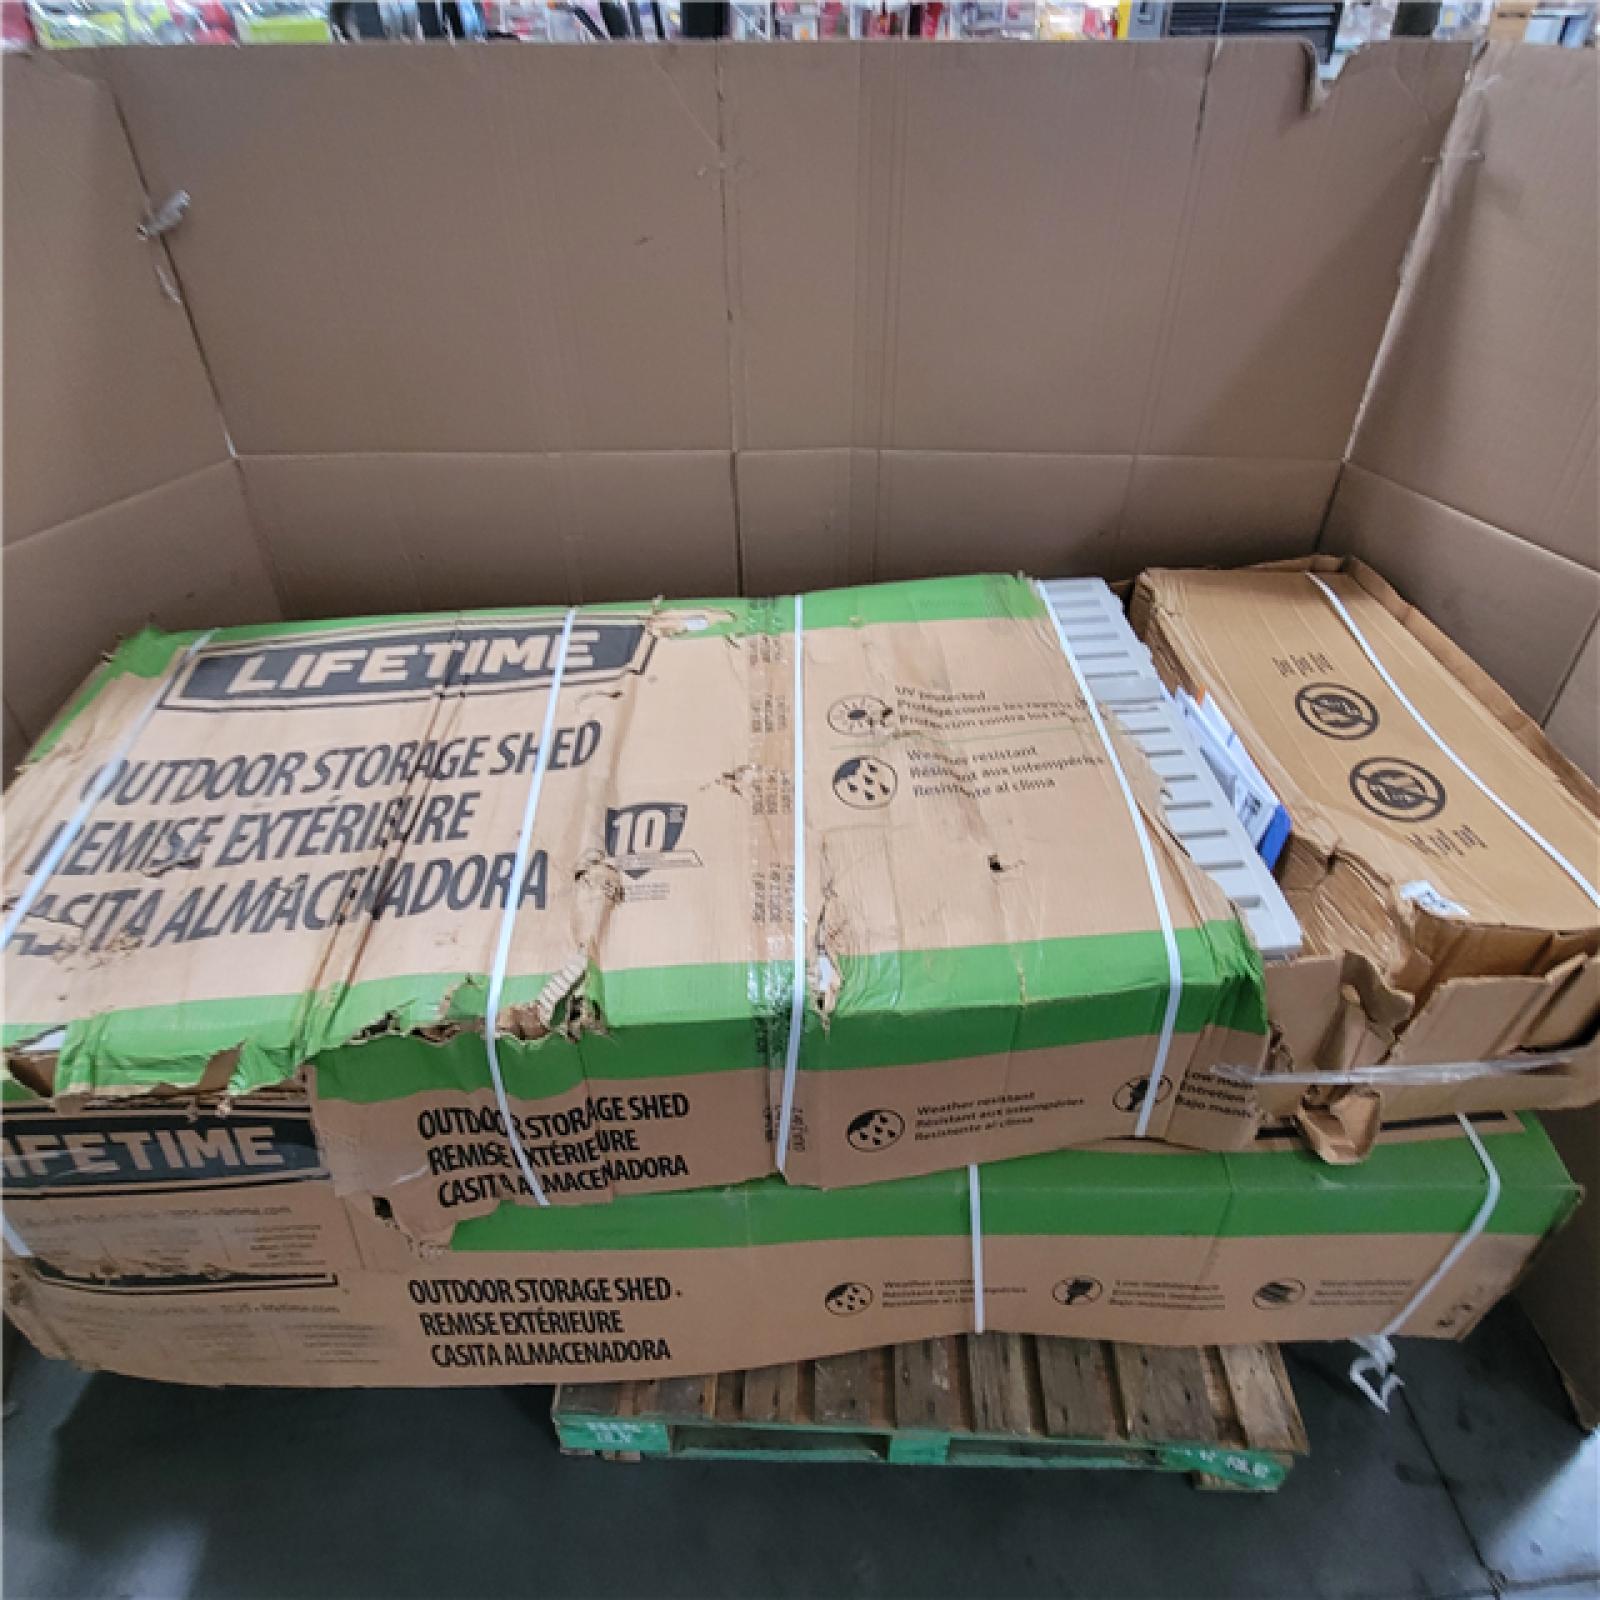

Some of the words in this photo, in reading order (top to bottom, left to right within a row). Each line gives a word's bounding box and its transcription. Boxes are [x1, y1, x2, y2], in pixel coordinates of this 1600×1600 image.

[227, 631, 600, 695] LIFETIME
[80, 751, 306, 806] OUTDOOR
[300, 736, 491, 794] STORAGE
[488, 720, 602, 776] SHED
[525, 1096, 627, 1139] STORAGE
[629, 1092, 690, 1121] SHED
[0, 1127, 284, 1178] IFETIME
[427, 1141, 512, 1176] REMISE
[518, 1155, 689, 1197] AMACENADORA
[408, 1278, 513, 1304] OUTDOOR
[514, 1277, 611, 1303] STORAGE
[614, 1276, 671, 1302] SHED
[419, 1311, 500, 1337] REMISE
[501, 1305, 624, 1336] EXTÉRIEURE
[431, 1343, 501, 1367] CASITA
[504, 1337, 671, 1366] ALMACENADORA
